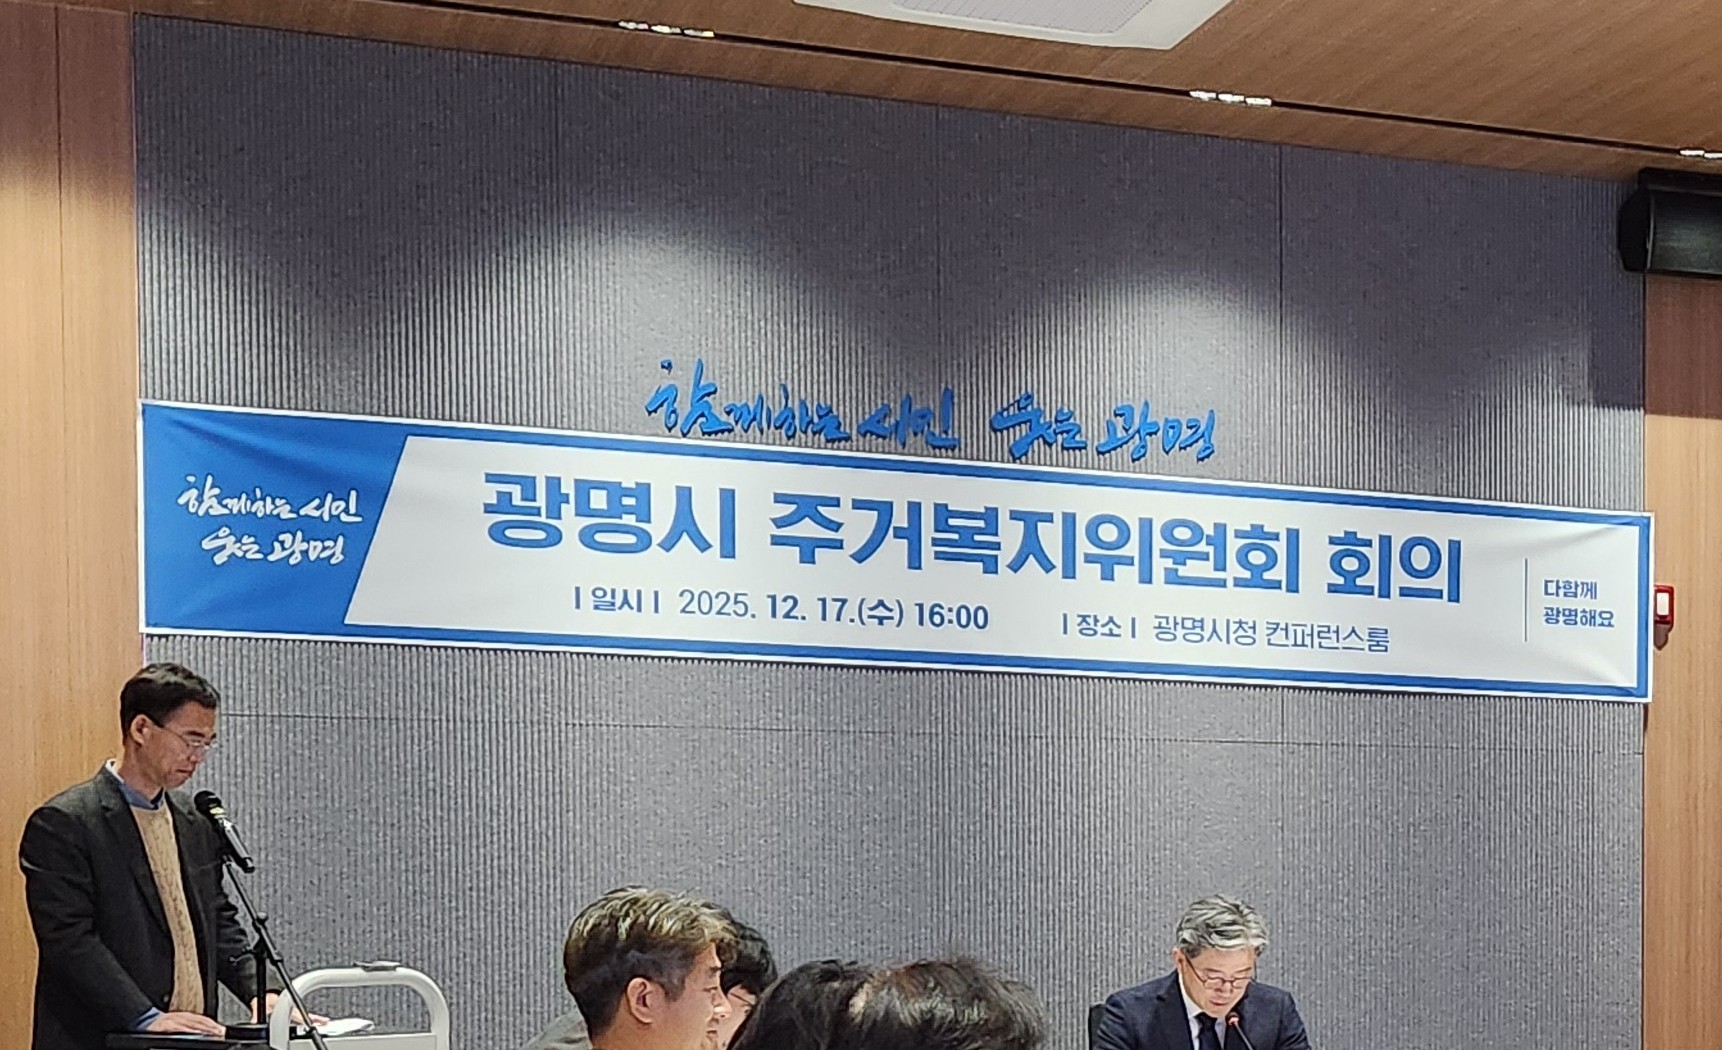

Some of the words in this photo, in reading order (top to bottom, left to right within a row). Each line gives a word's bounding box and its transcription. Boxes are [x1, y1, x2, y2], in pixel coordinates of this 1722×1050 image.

[645, 358, 850, 442] 함께하는
[858, 386, 959, 449] 시민
[990, 391, 1087, 462] 웃는
[1096, 400, 1215, 462] 광명
[177, 474, 298, 519] 함께하는
[299, 489, 363, 522] 시민
[201, 526, 264, 565] 웃는
[267, 530, 344, 565] 광명
[483, 472, 736, 559] 광명시
[770, 492, 1300, 594] 주거복지위원회
[1328, 531, 1462, 603] 회의
[591, 587, 643, 614] 일시
[678, 589, 756, 619] 2025.
[767, 593, 806, 621] 12.
[914, 601, 990, 630] 16:00
[1543, 579, 1597, 600] 다함께
[1077, 613, 1122, 638] 장소
[1152, 614, 1257, 646] 광명시청
[1265, 620, 1390, 653] 컨퍼런스룸
[1543, 607, 1615, 628] 광명해요
